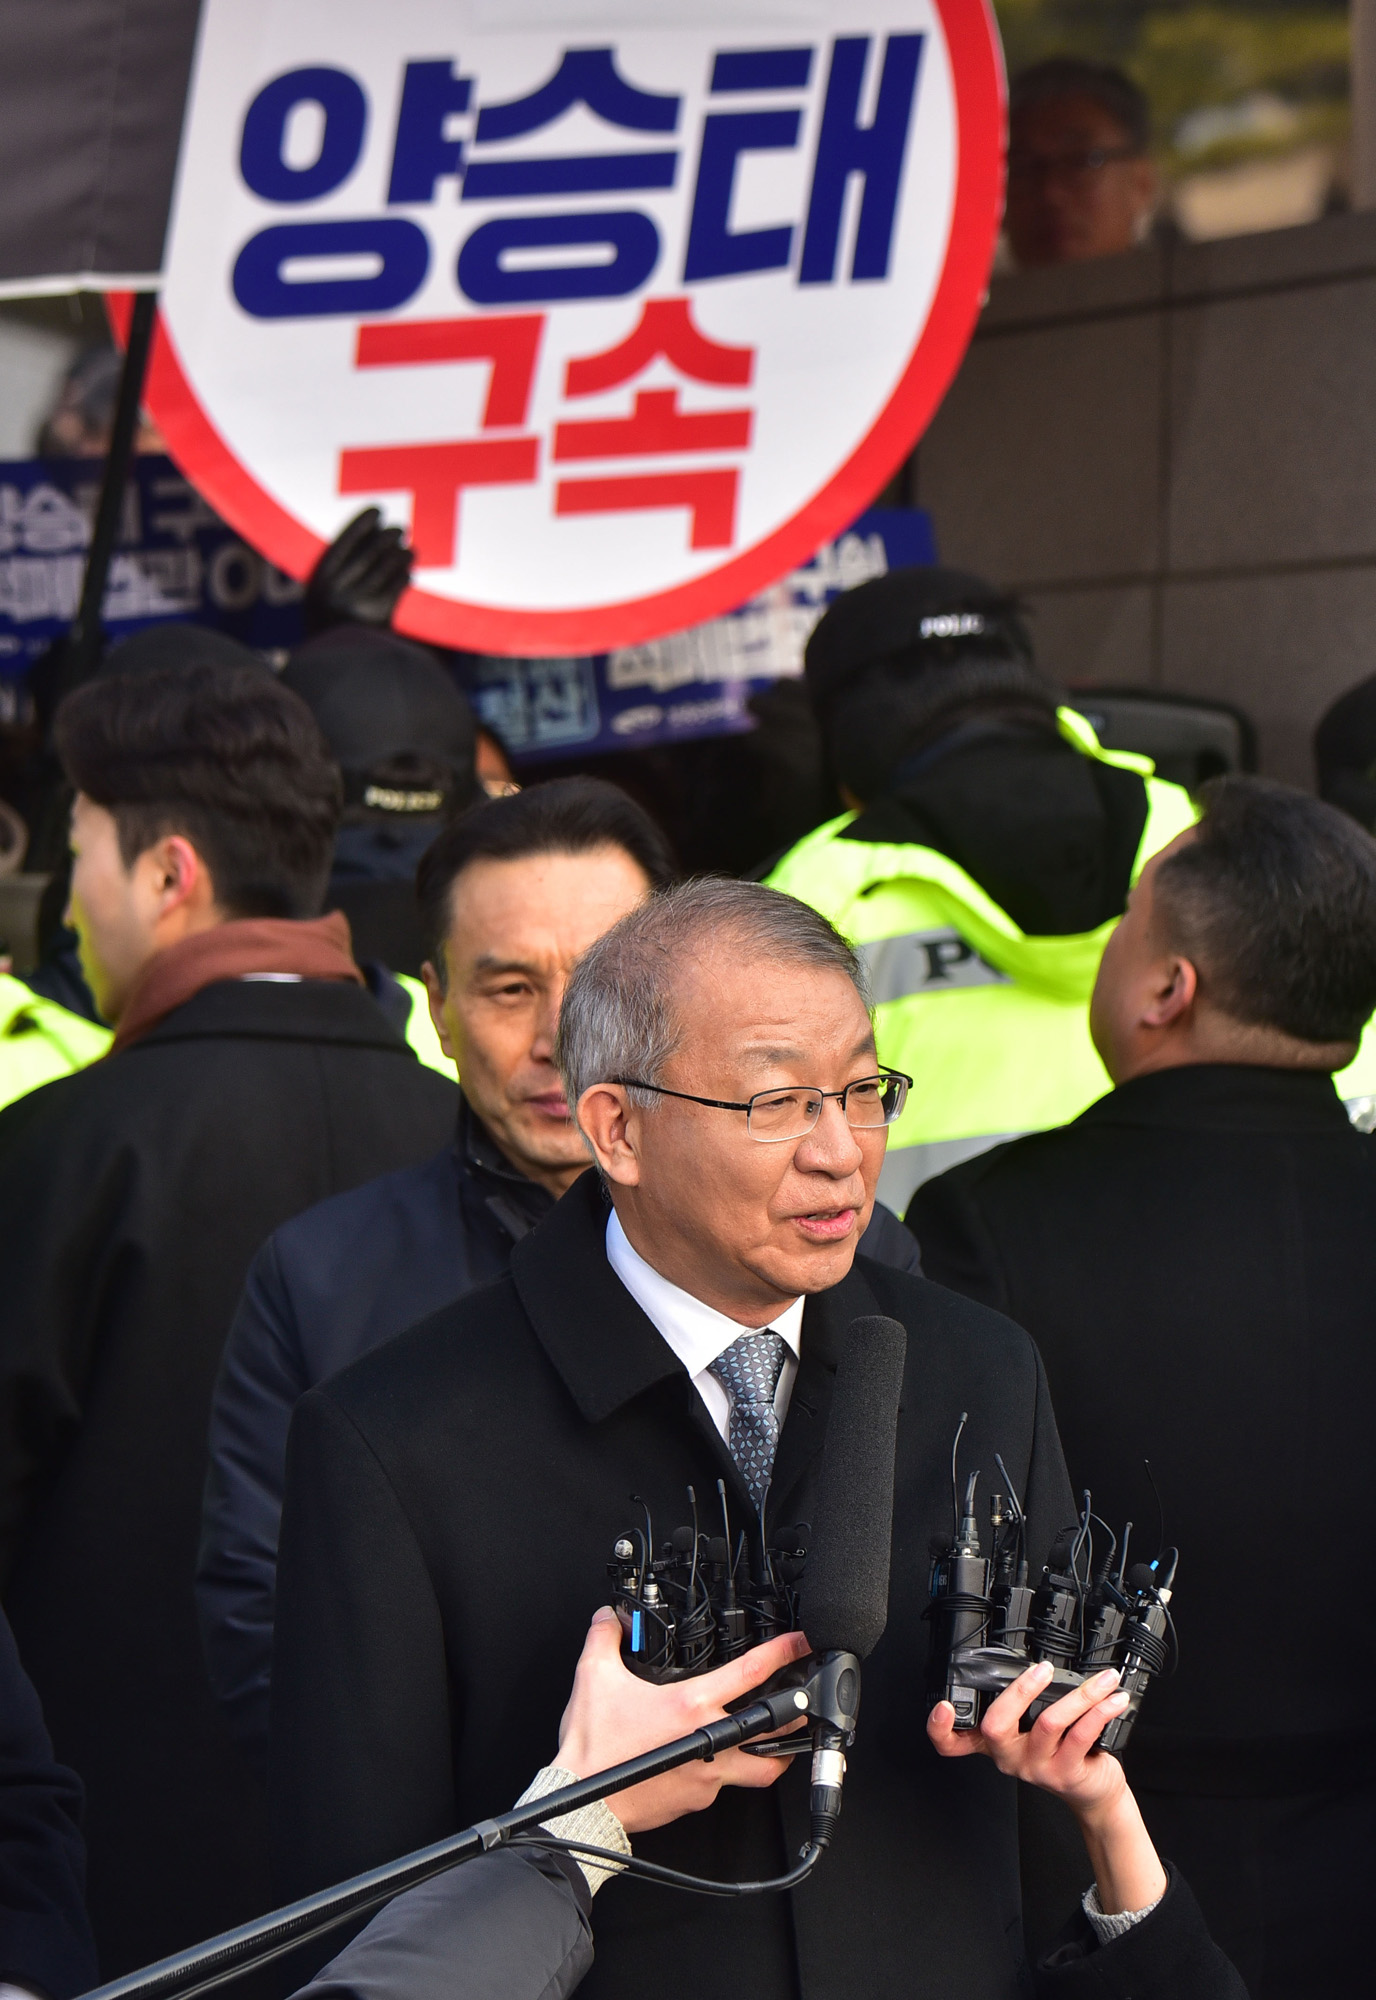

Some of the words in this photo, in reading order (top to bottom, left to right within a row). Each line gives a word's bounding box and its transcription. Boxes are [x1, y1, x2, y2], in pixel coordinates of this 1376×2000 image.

[232, 33, 926, 321] 양승태
[337, 297, 756, 572] 구속
[919, 612, 985, 640] POLIC
[364, 785, 444, 812] POLICE
